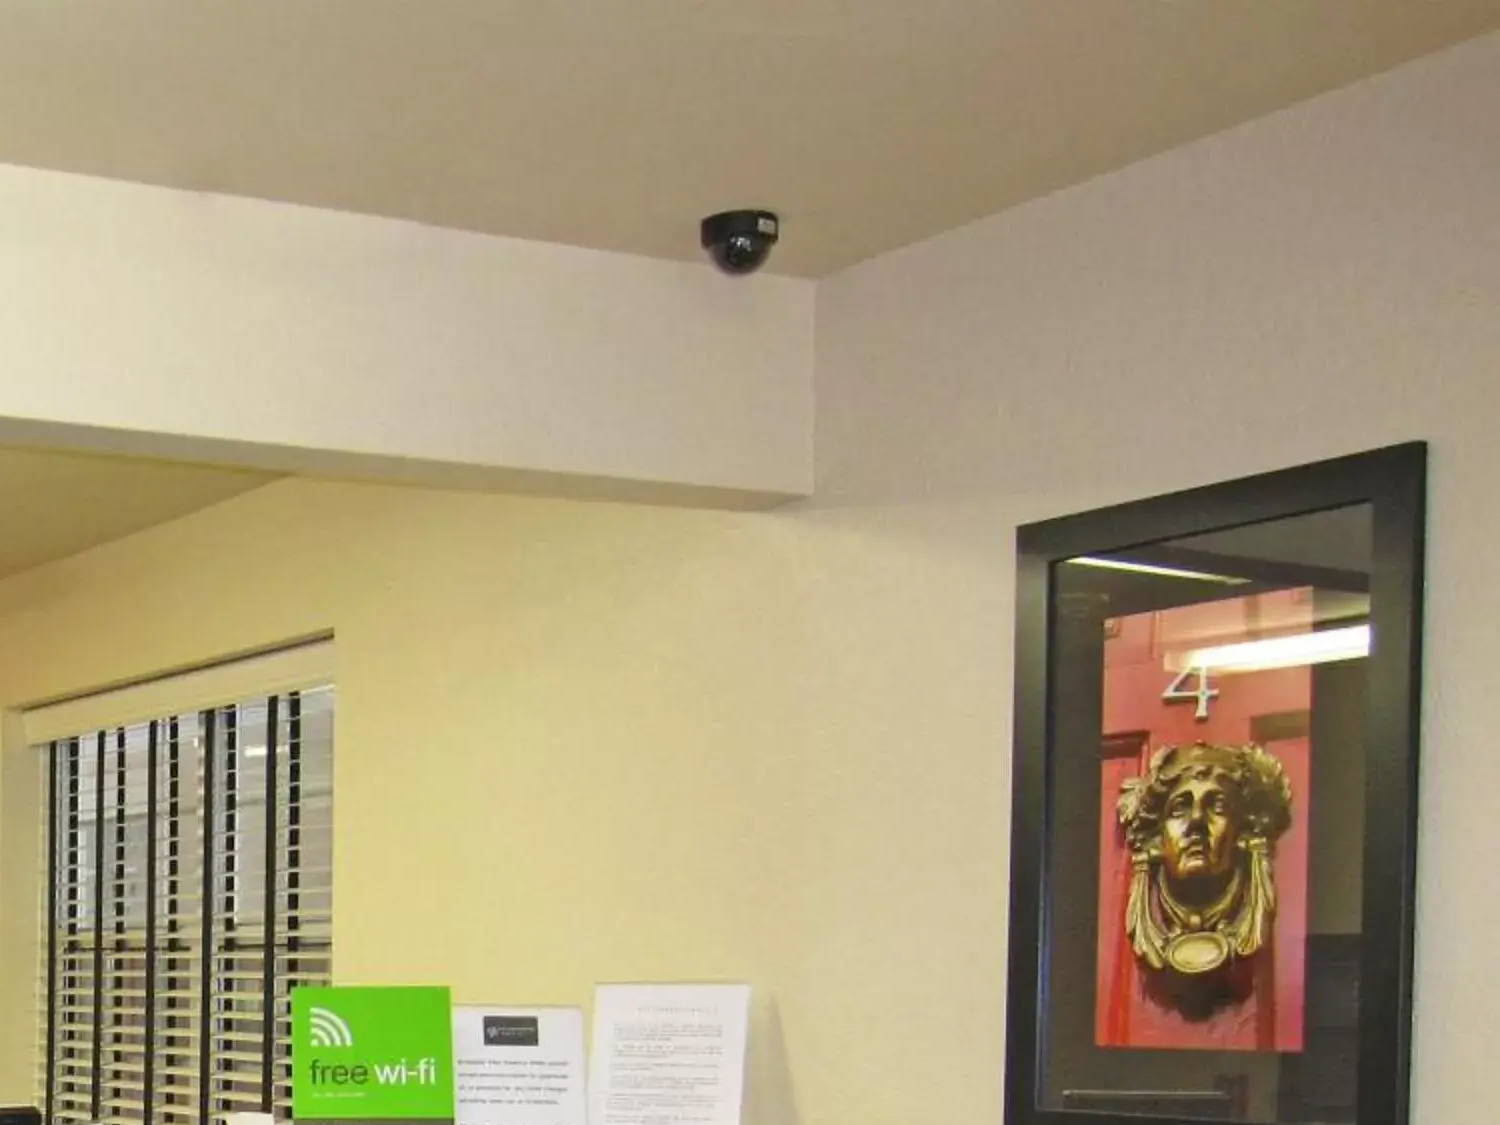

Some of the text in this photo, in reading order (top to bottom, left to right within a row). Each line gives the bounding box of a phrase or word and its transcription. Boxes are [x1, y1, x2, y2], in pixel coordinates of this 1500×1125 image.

[1160, 662, 1220, 717] 4
[309, 1058, 369, 1085] free
[374, 1056, 437, 1085] wi-fi
